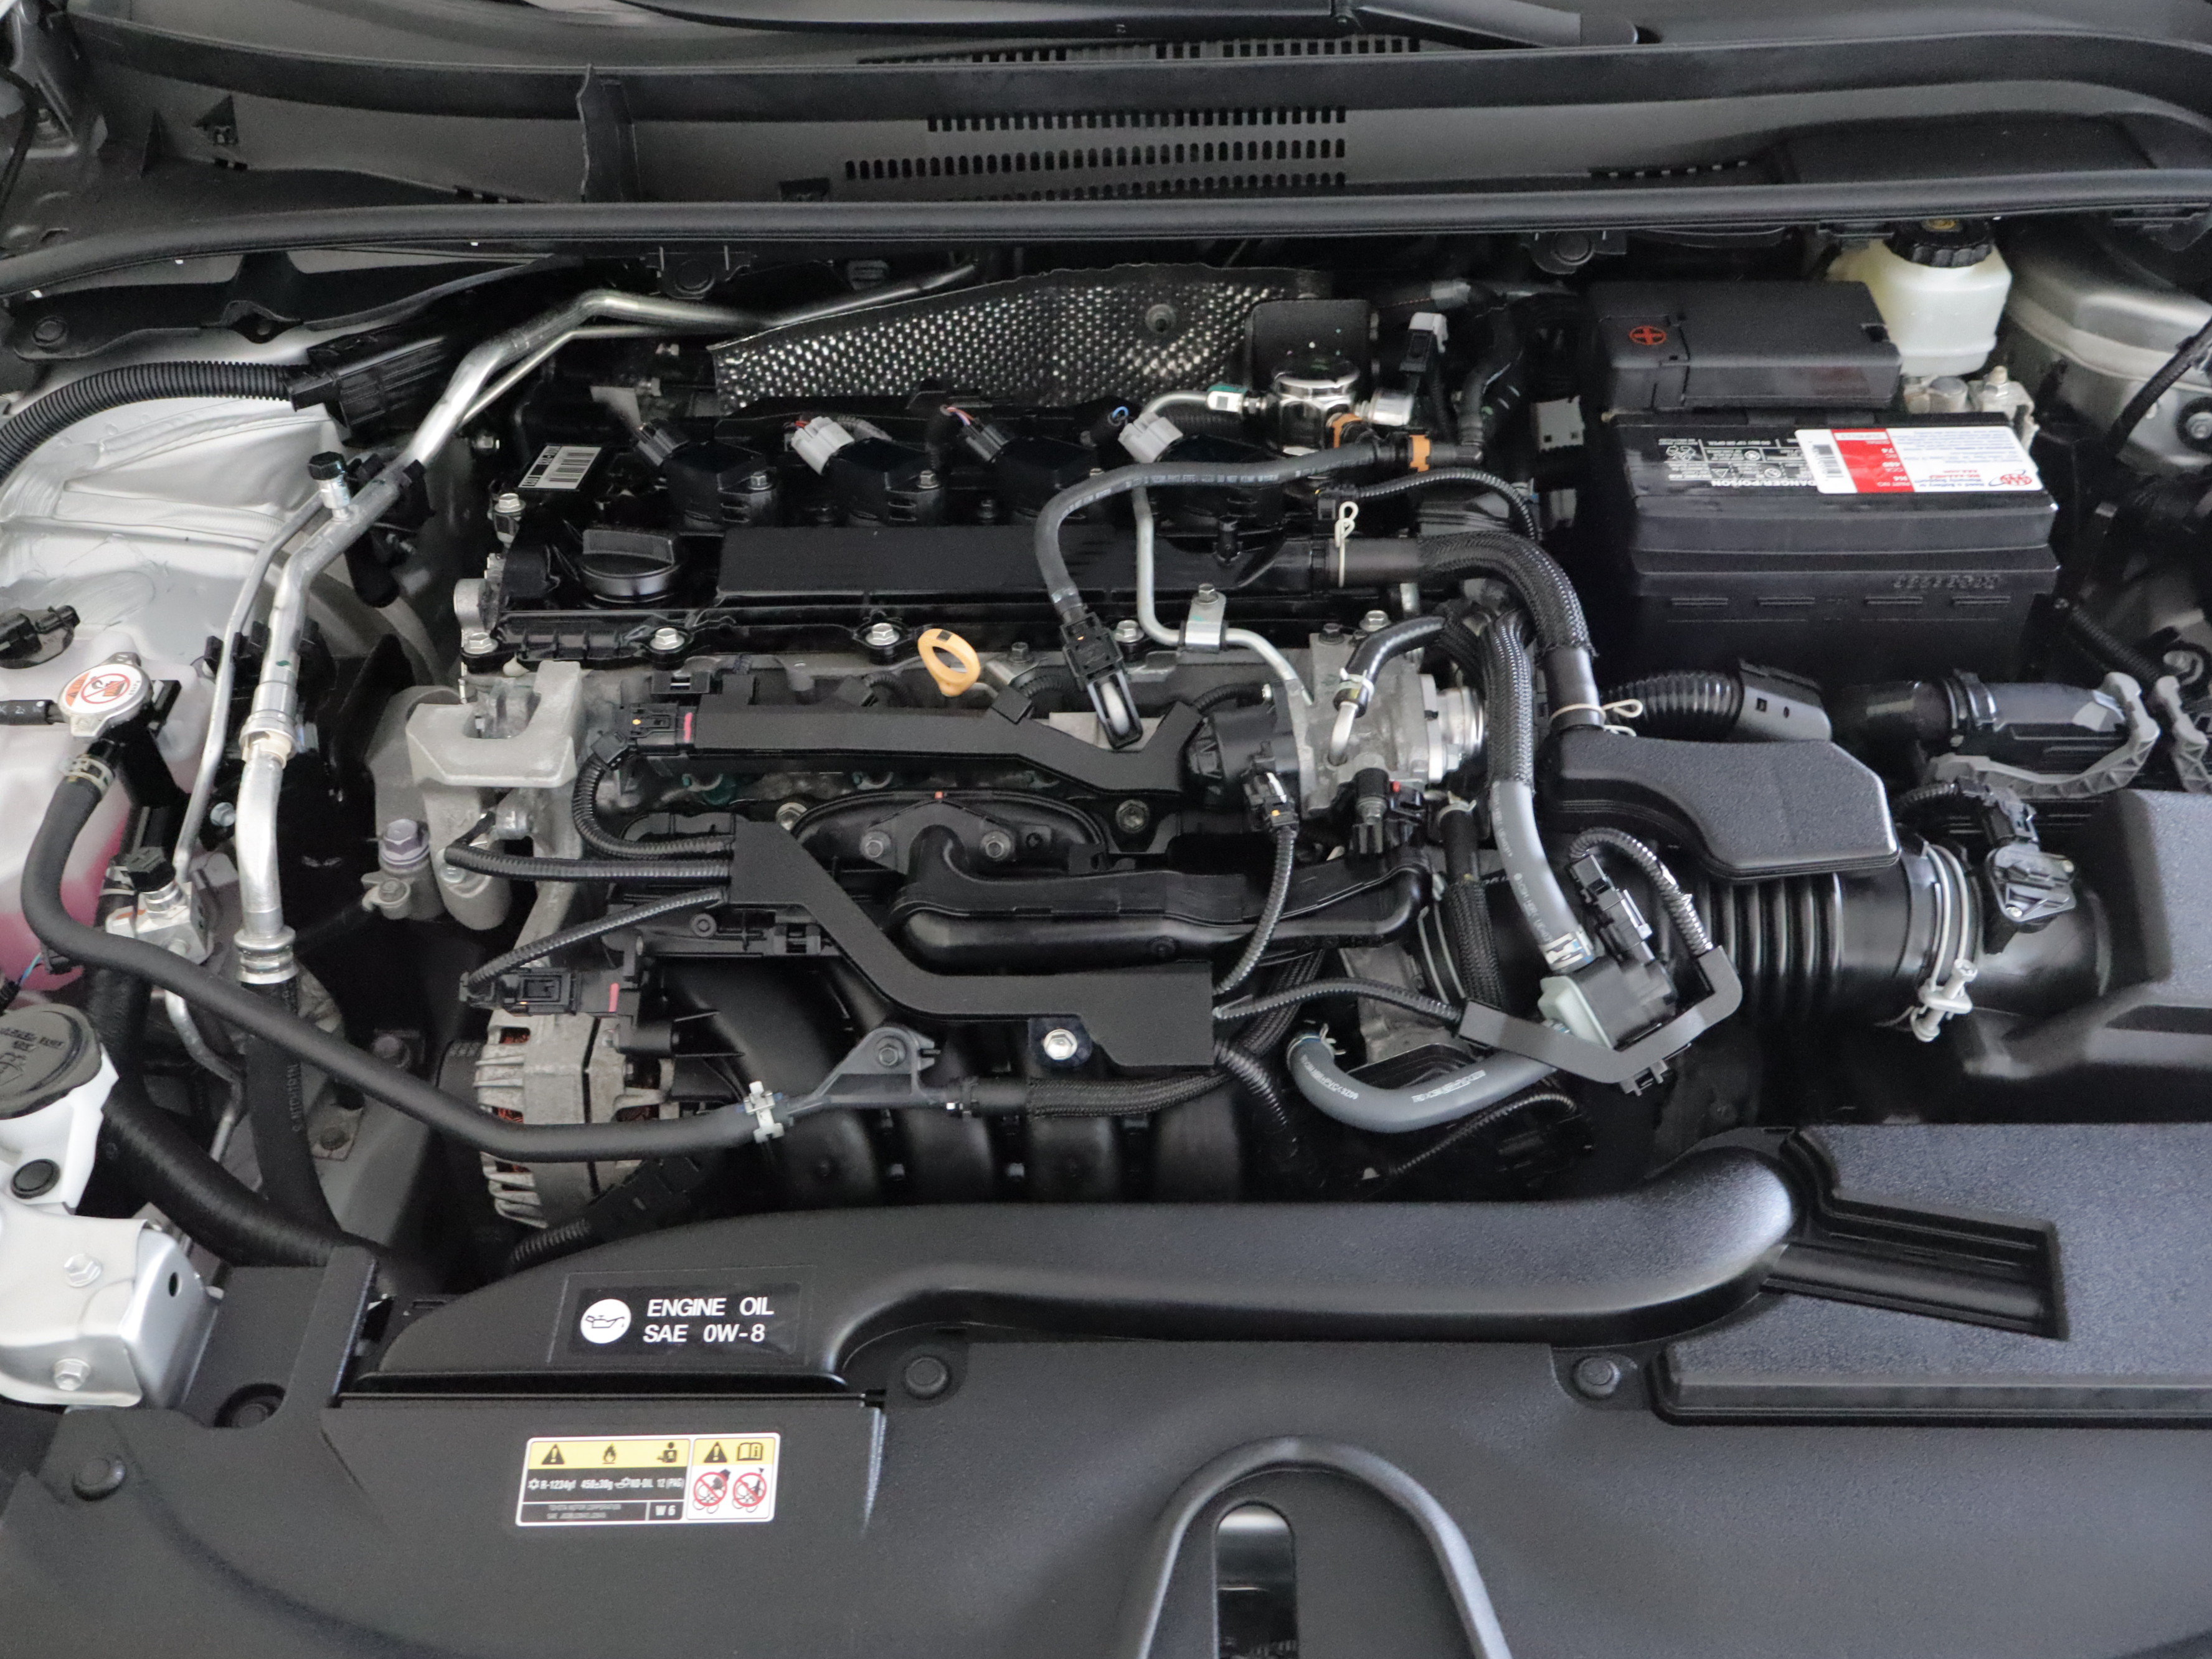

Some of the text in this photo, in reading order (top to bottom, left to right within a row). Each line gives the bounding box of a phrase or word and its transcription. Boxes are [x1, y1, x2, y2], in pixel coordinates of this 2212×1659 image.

[646, 1297, 774, 1316] ENGINE OIL
[643, 1323, 765, 1343] SAE 0W-8
